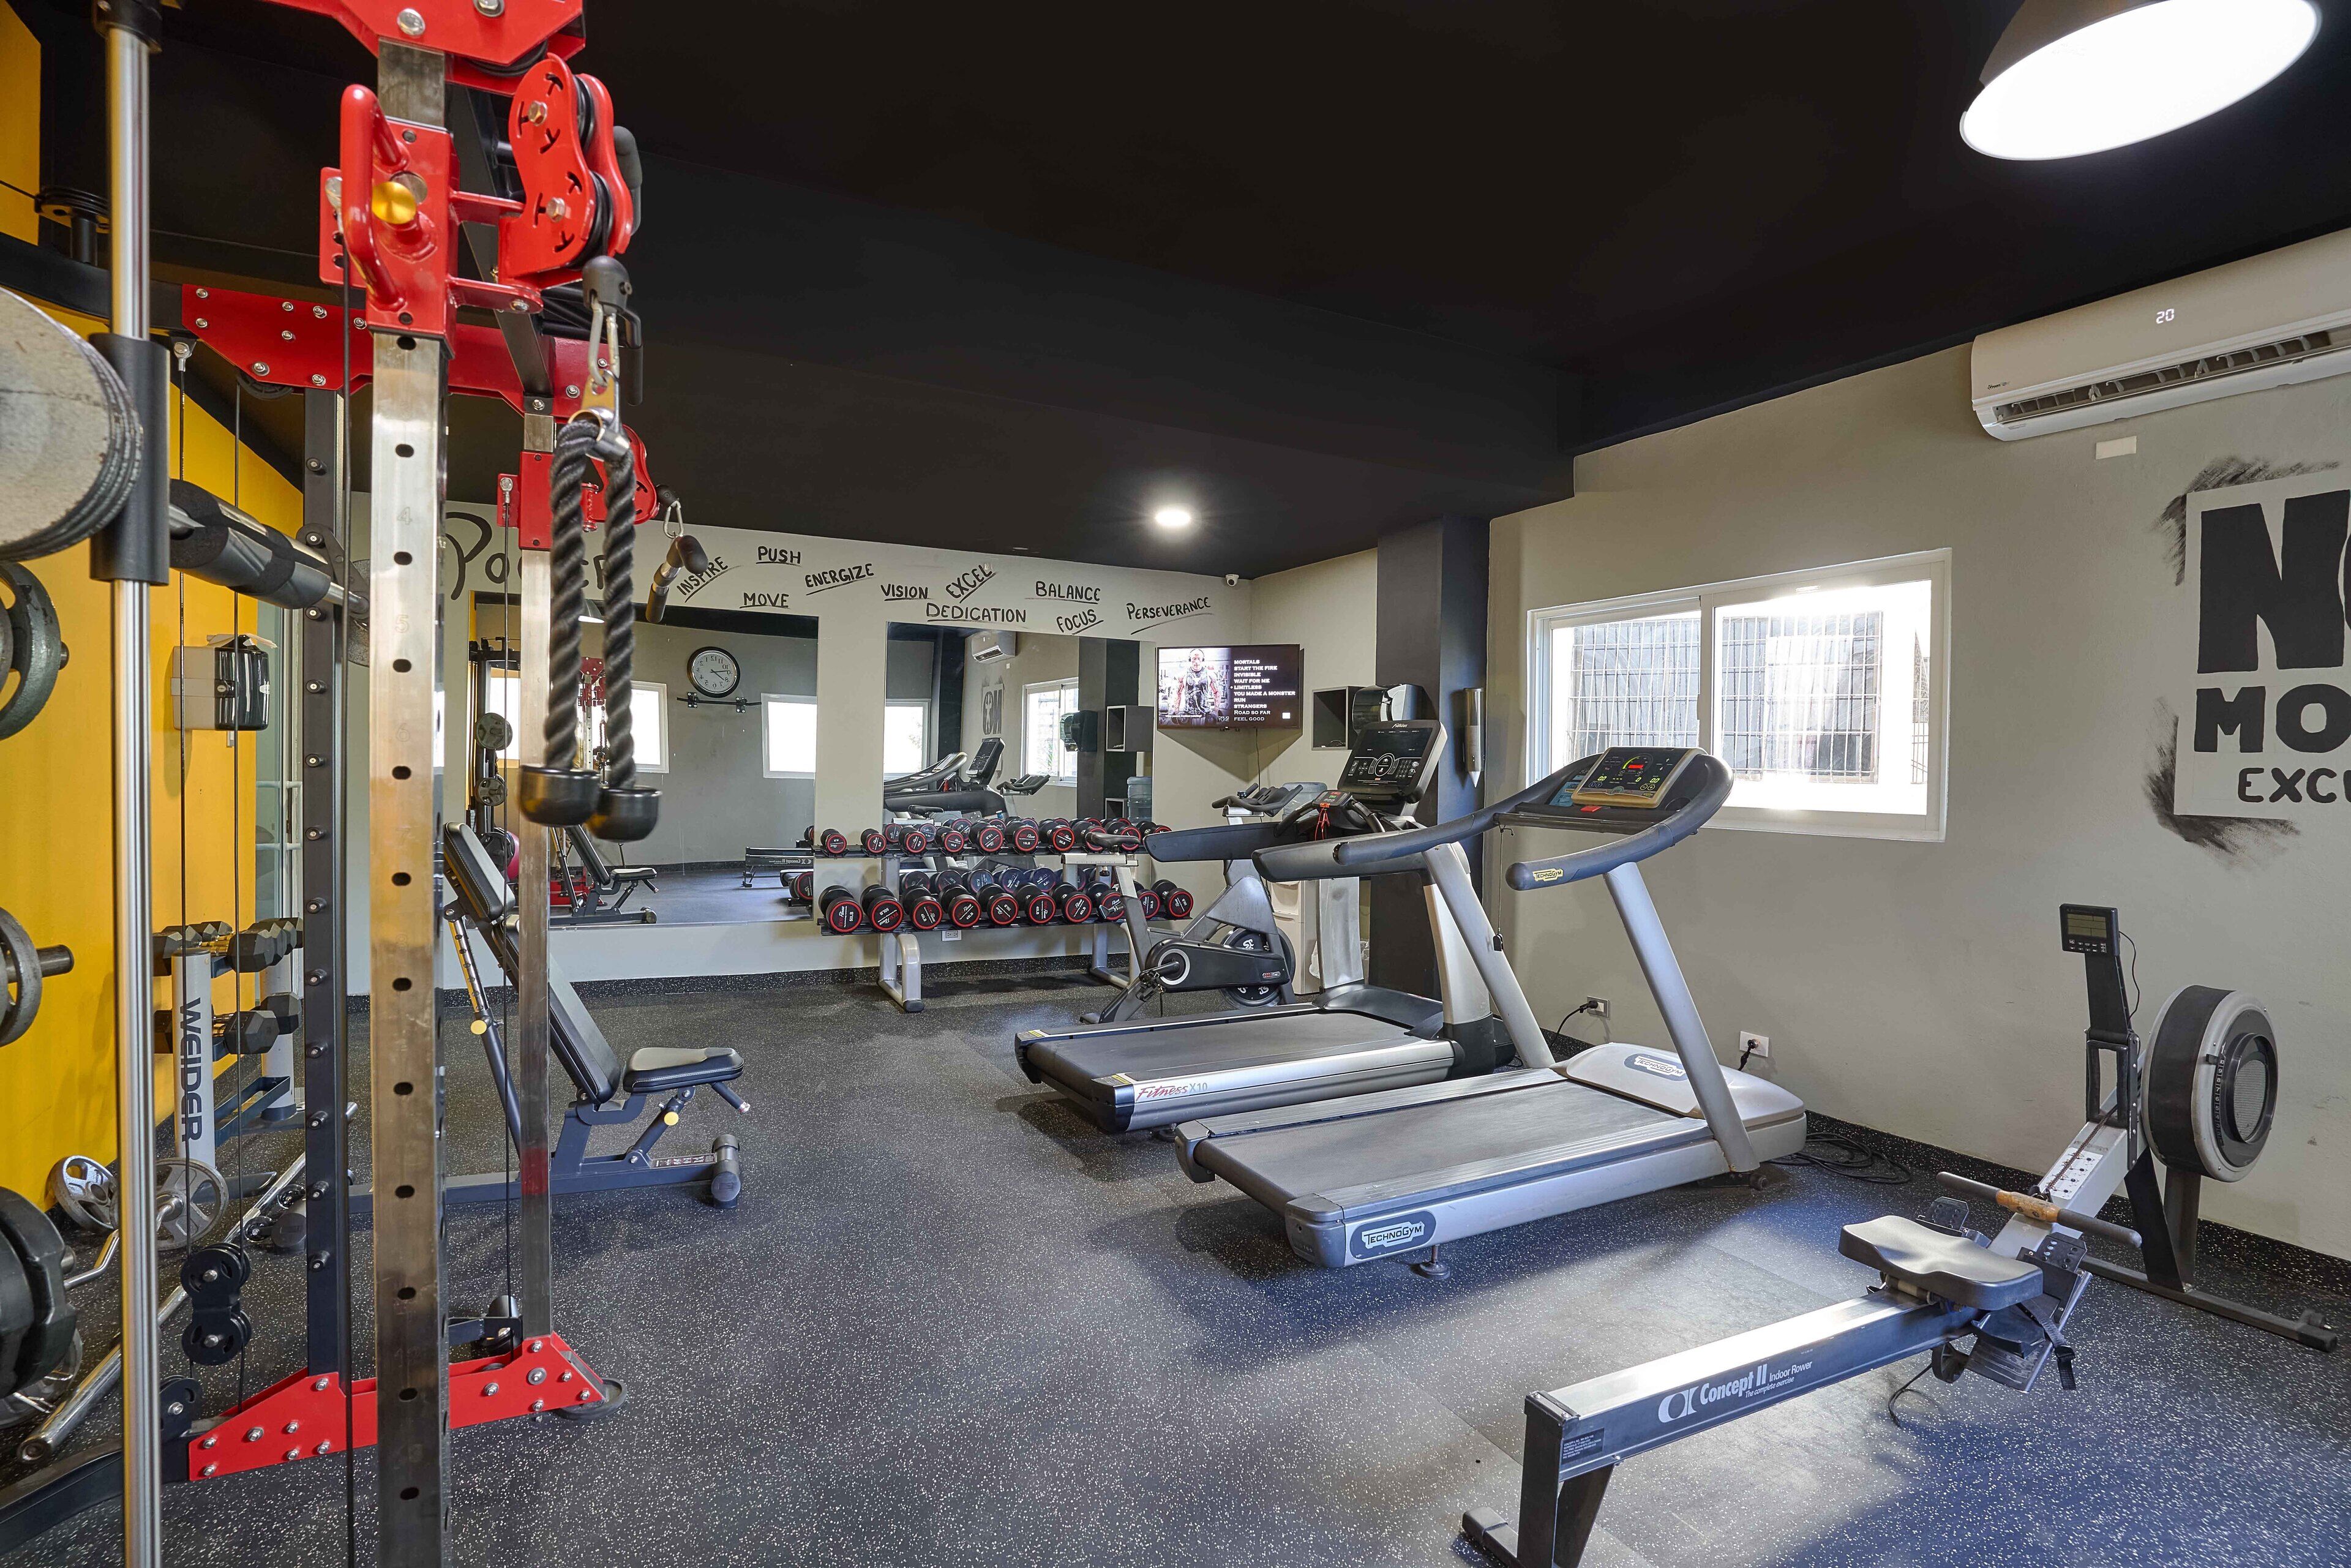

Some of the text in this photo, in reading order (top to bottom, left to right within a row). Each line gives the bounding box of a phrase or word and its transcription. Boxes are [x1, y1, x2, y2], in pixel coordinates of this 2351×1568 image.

[2156, 309, 2175, 324] 20
[398, 506, 413, 525] 4
[757, 546, 801, 564] PUSH
[677, 557, 729, 595] INSPIRE
[804, 563, 874, 588] ENERGIZE
[945, 563, 992, 599] EXCEL
[2197, 489, 2351, 673] N
[744, 592, 789, 608] MOVE
[880, 584, 929, 599] VISION
[1035, 580, 1101, 602] BALANCE
[926, 602, 1026, 623] DEDICATION
[1127, 596, 1211, 620] PERSEVERANCE
[395, 615, 410, 633] 5
[1056, 609, 1097, 634] FOCUS
[179, 997, 203, 1142] WEIDER
[1136, 1082, 1208, 1101] Fitness X10
[1700, 1361, 1813, 1405] Concept II Indoor Rower
[1754, 1383, 1775, 1395] complete
[1776, 1376, 1794, 1387] exercise
